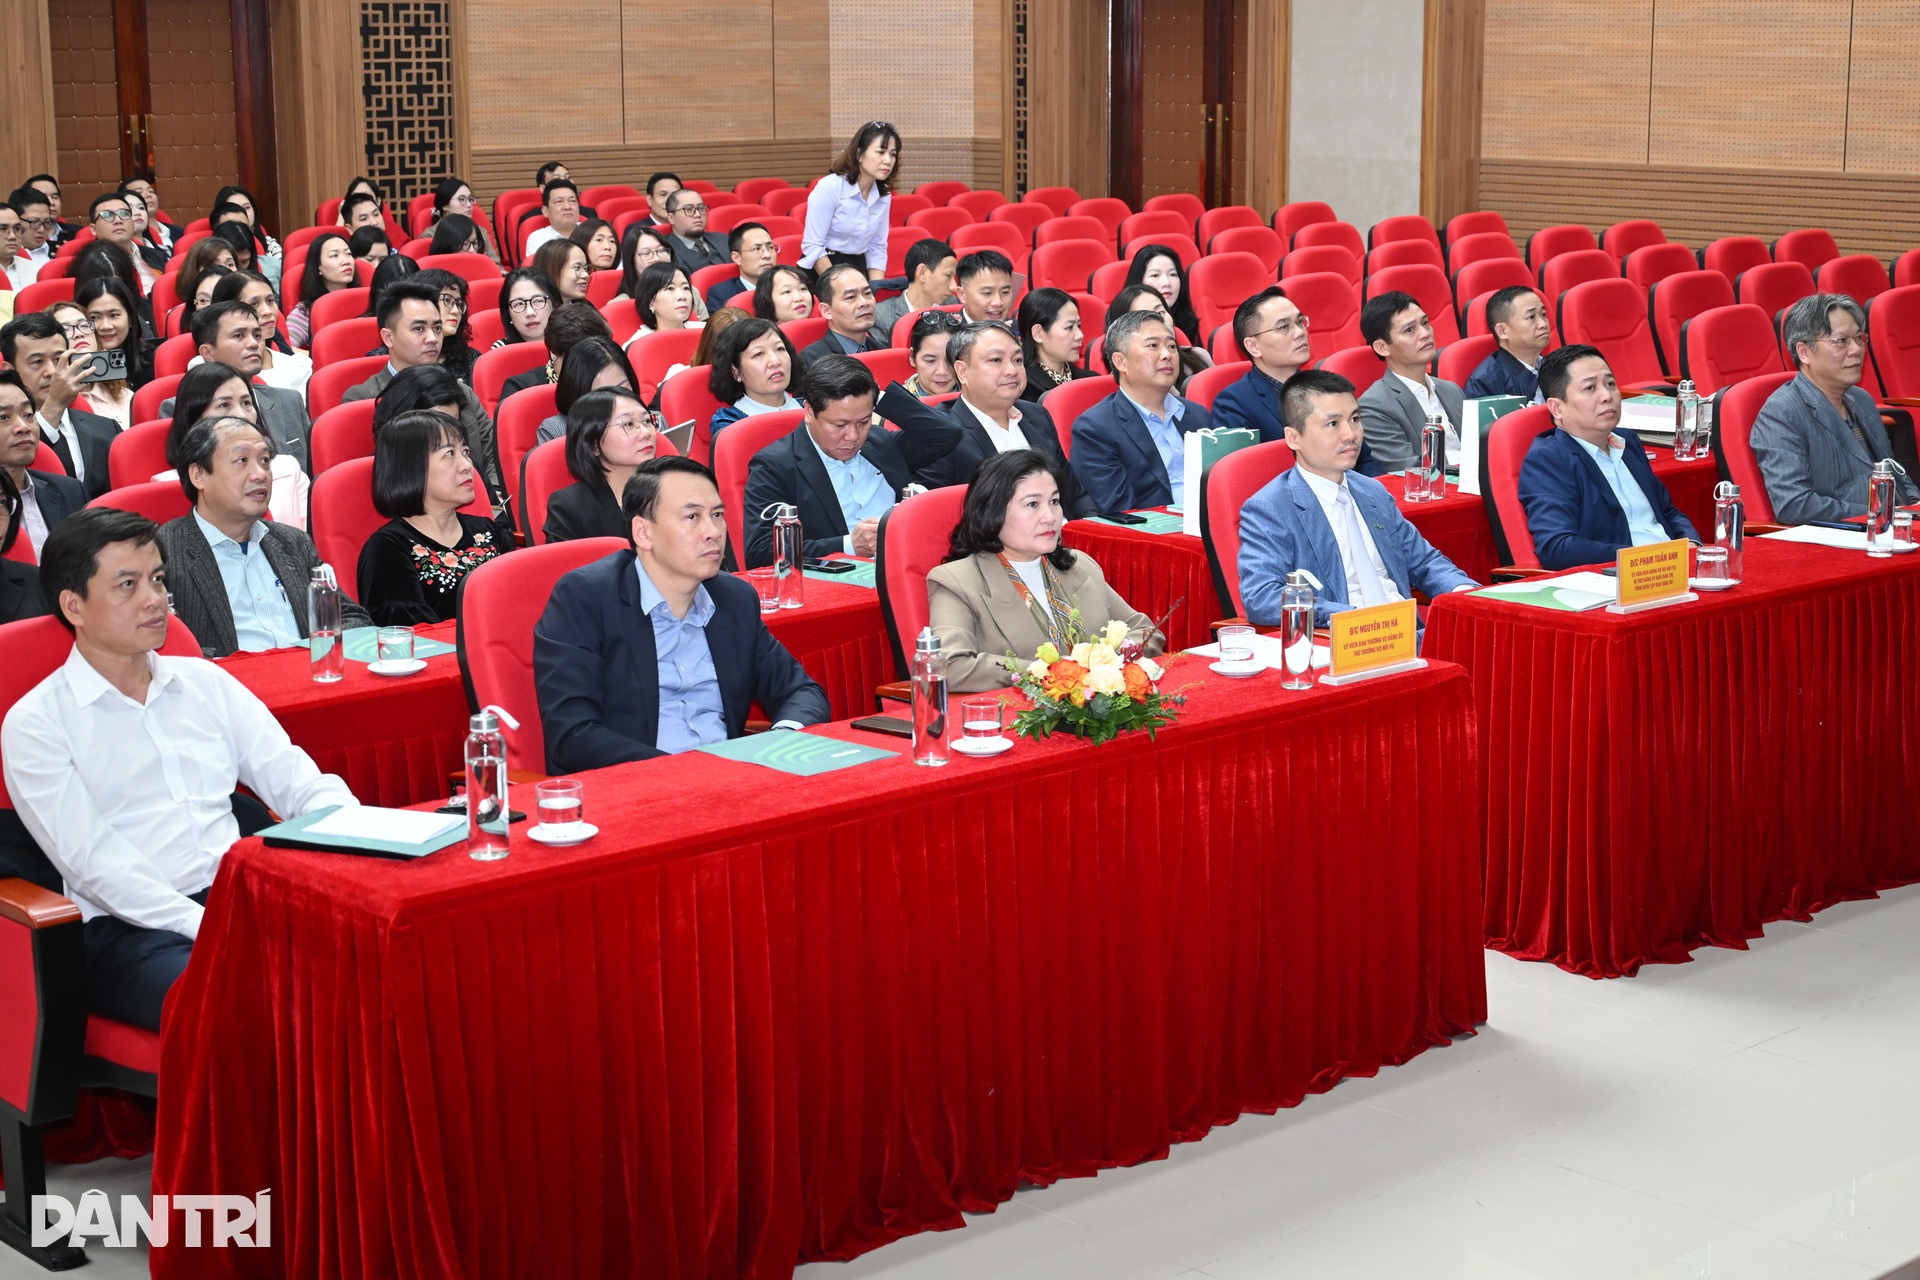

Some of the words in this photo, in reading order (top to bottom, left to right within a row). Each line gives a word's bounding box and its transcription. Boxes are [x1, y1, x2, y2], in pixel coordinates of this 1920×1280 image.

[1630, 558, 1638, 567] Đ/C
[1640, 556, 1653, 566] PHẠM
[1655, 551, 1667, 563] TUẤN
[1668, 552, 1678, 560] ANH
[1350, 626, 1358, 635] Đ/C
[1360, 620, 1380, 633] NGUYỄN
[1391, 617, 1398, 628] HÀ
